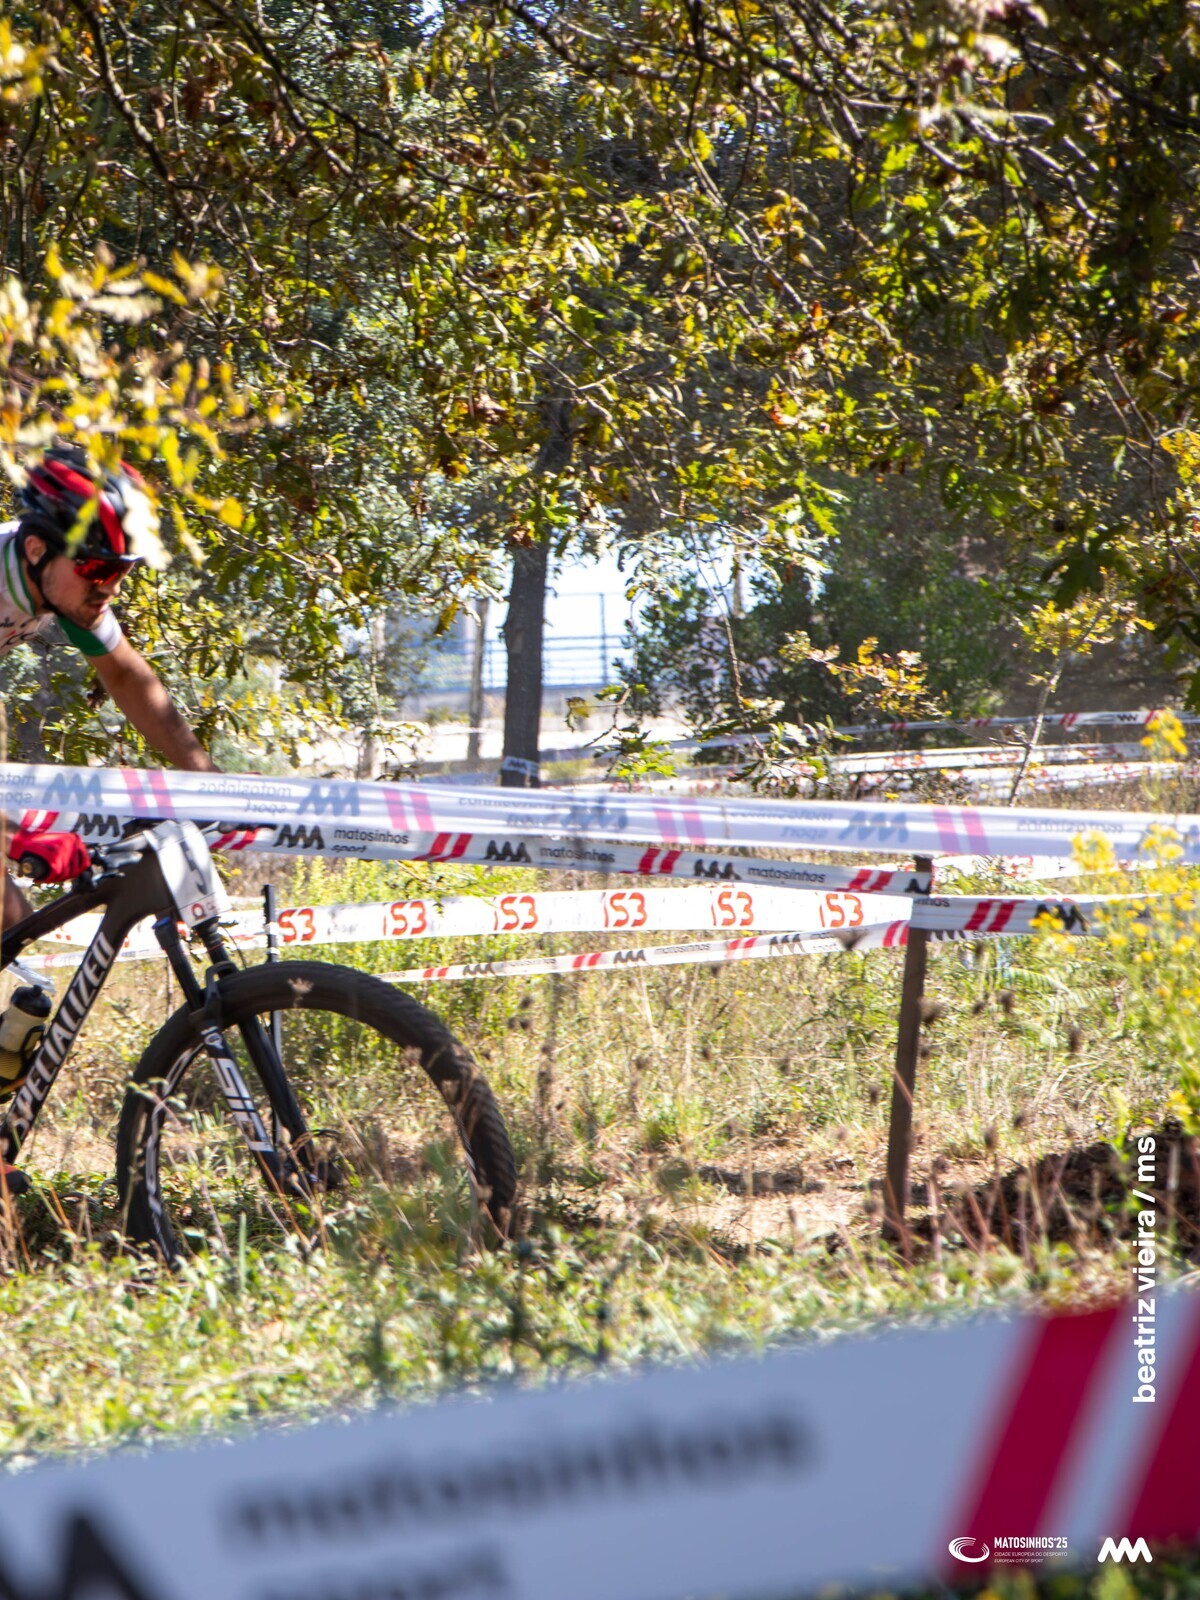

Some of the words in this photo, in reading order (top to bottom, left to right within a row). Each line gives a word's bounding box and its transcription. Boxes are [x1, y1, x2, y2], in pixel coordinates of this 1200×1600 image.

[333, 827, 410, 845] matosinhos
[540, 846, 615, 863] matosinhos
[748, 865, 826, 883] matosinhos
